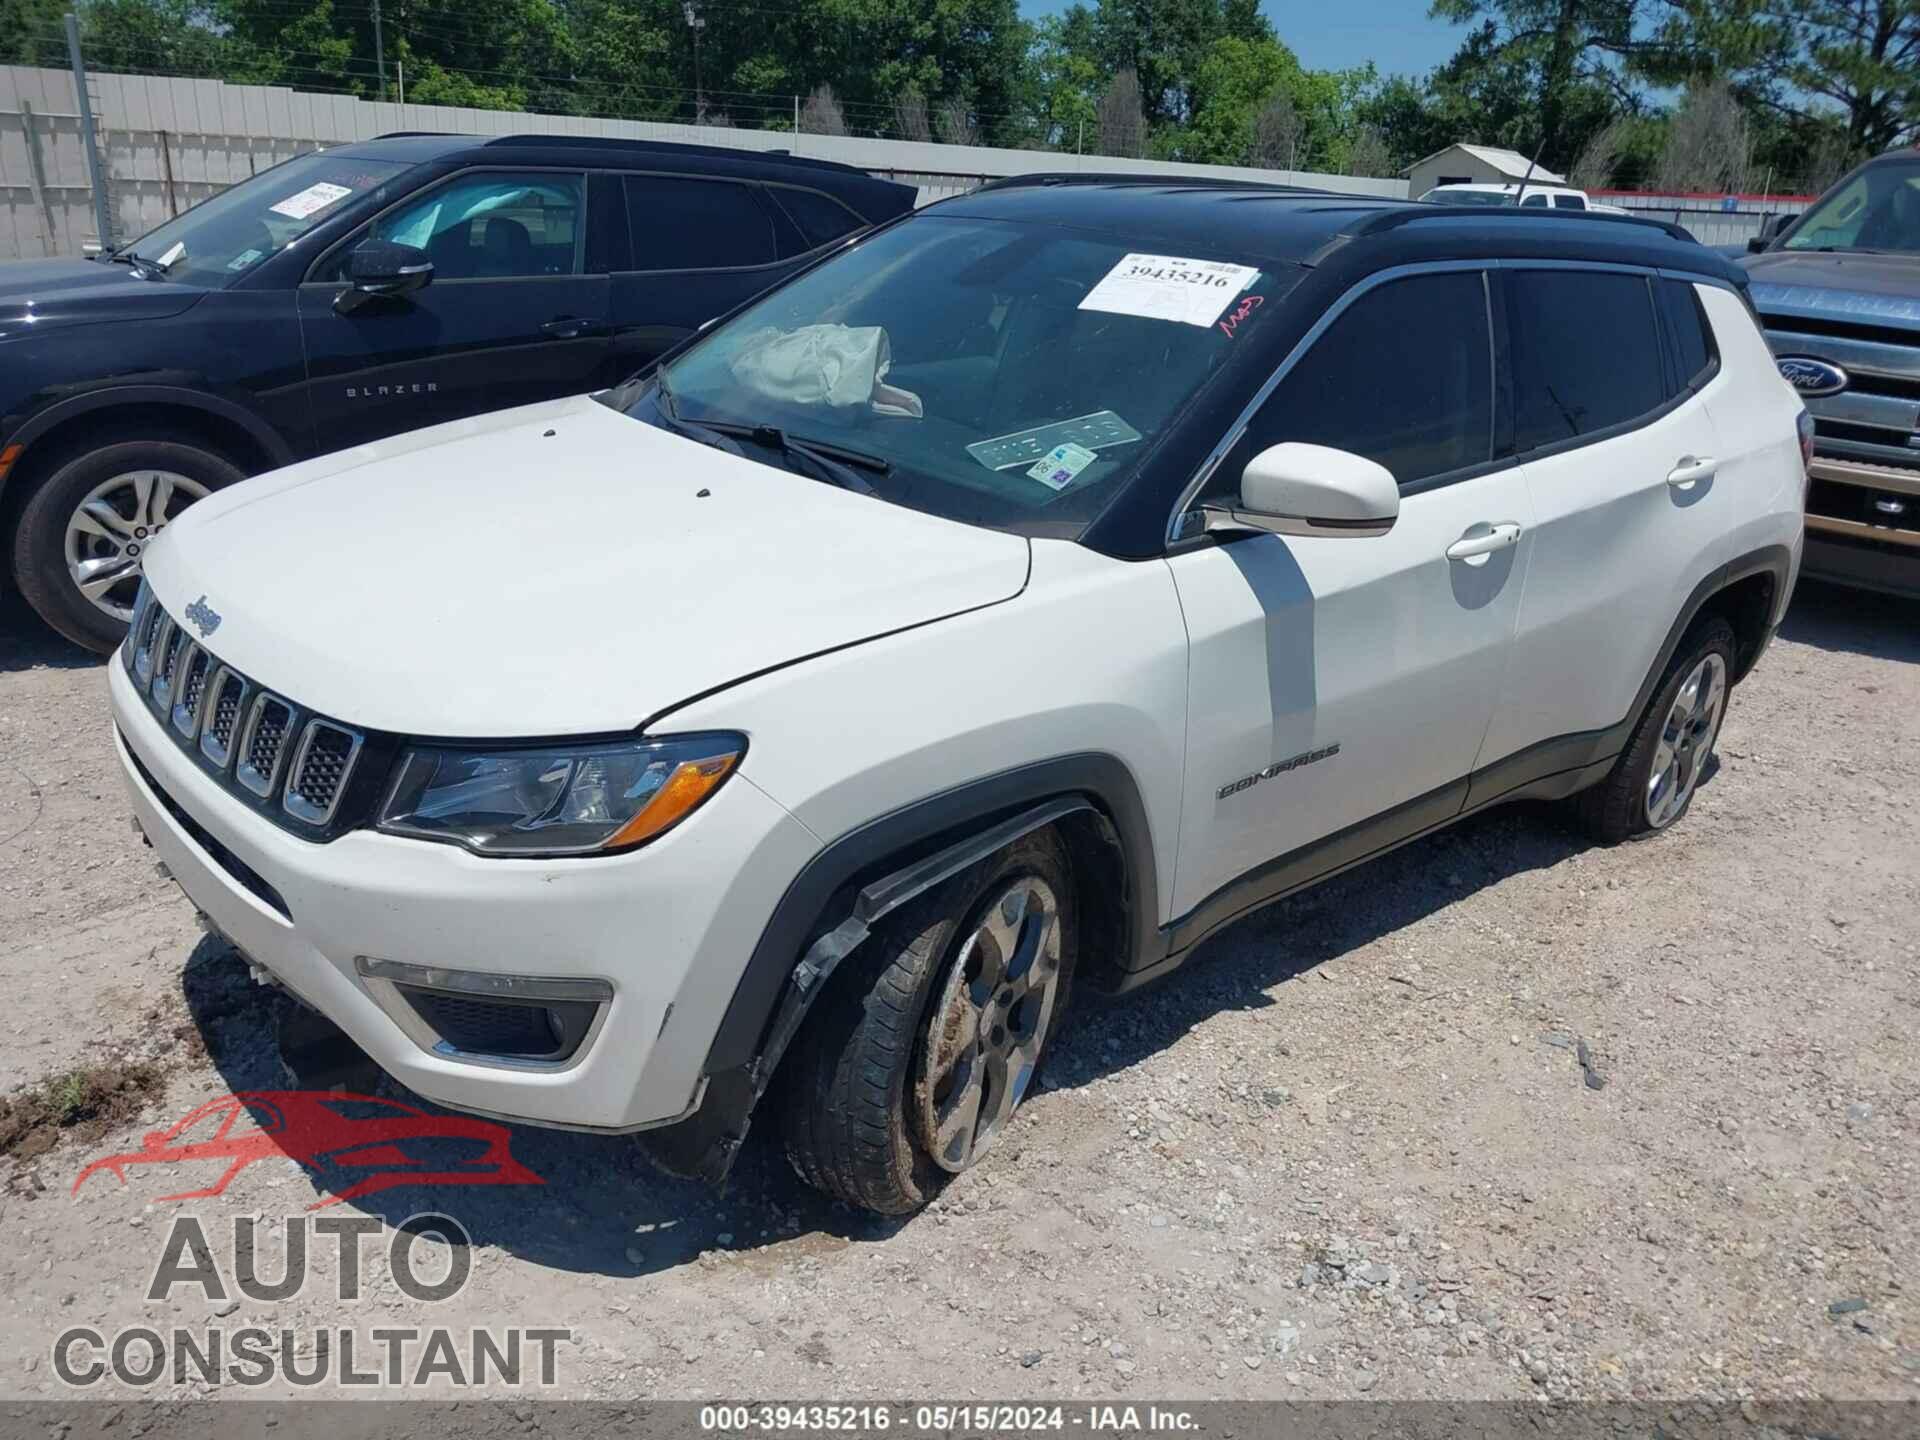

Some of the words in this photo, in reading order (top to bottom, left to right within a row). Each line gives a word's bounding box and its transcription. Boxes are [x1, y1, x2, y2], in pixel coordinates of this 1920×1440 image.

[1122, 264, 1229, 289] 39435216
[1782, 363, 1824, 386] Ford
[346, 383, 438, 397] BLAZER
[1216, 744, 1341, 800] COMPASS
